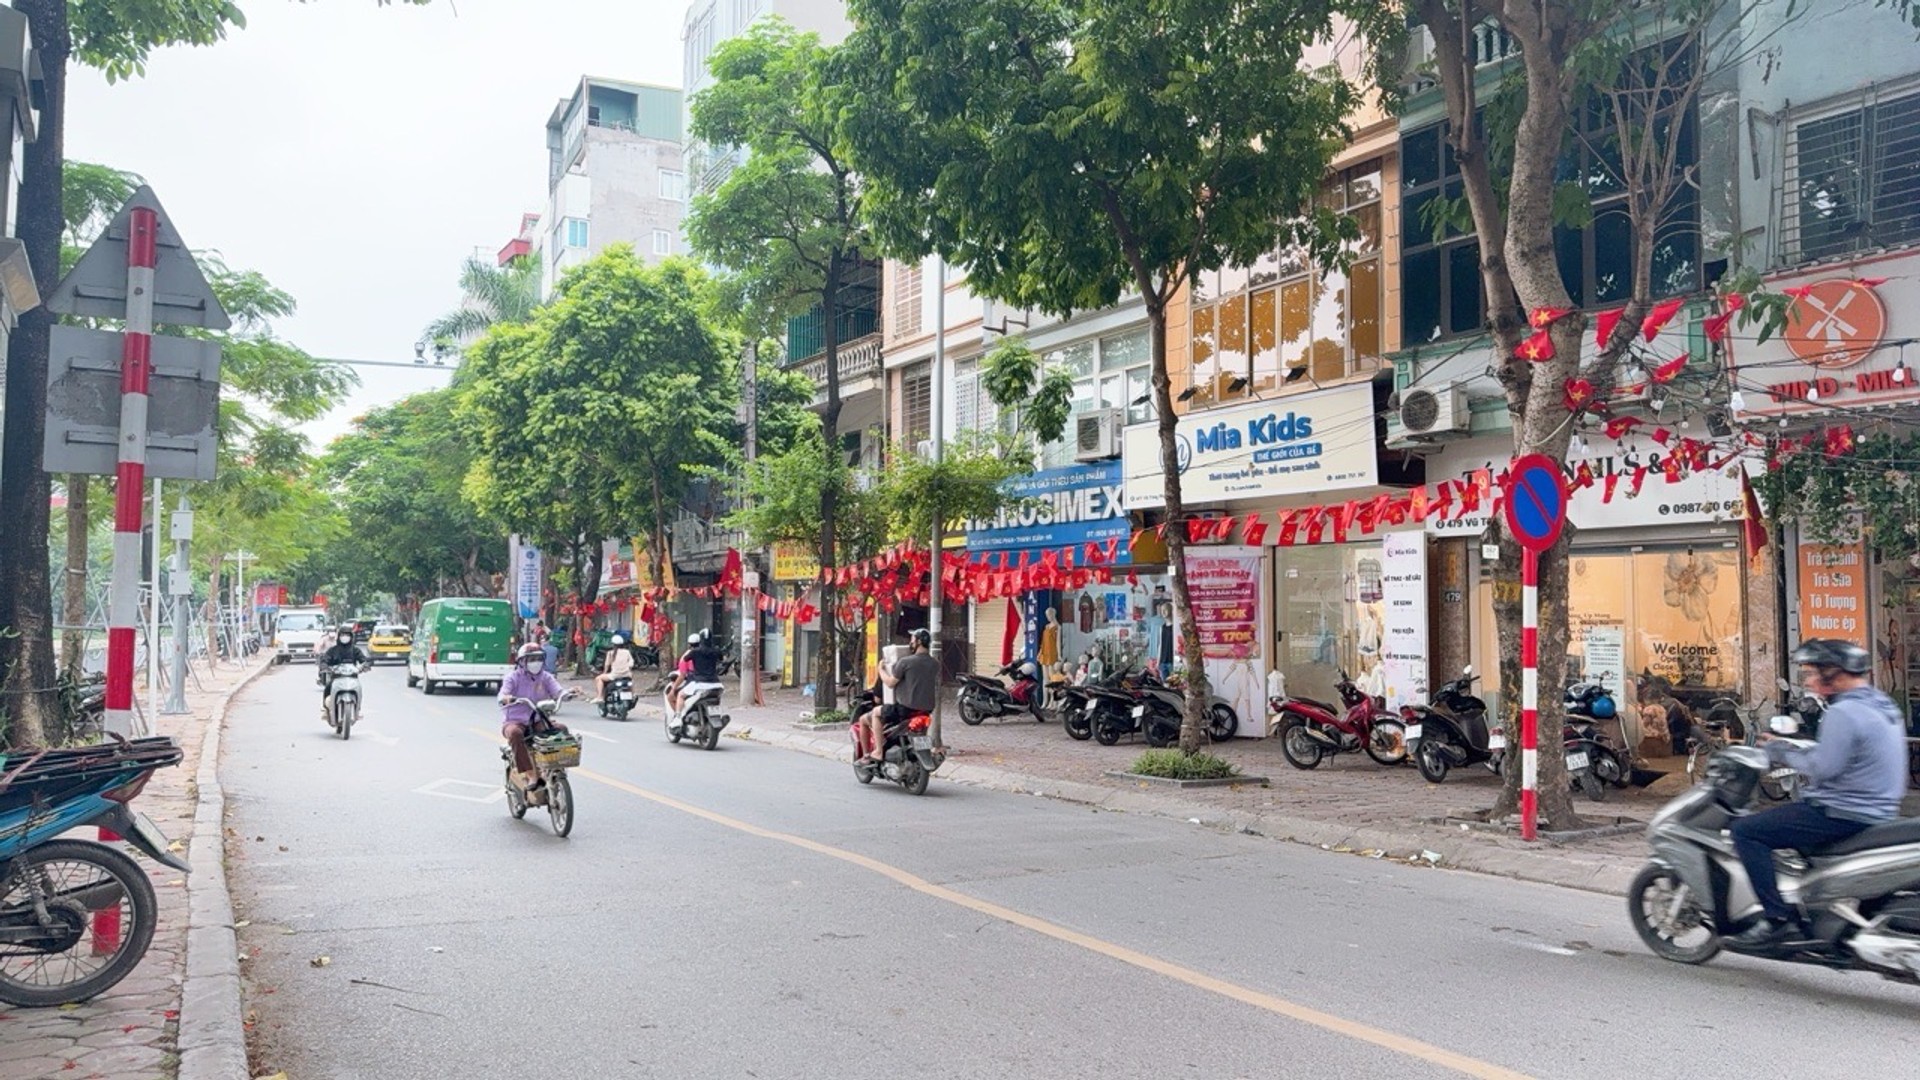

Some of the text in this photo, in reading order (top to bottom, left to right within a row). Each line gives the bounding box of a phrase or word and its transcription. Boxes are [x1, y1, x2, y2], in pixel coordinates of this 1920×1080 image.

[1197, 412, 1312, 453] Mia Kids
[1648, 453, 1663, 474] &
[1673, 502, 1701, 514] 0987
[1466, 518, 1478, 527] Vũ
[1813, 572, 1830, 587] Trà
[1811, 615, 1840, 630] Nước
[1653, 642, 1718, 655] Welcome
